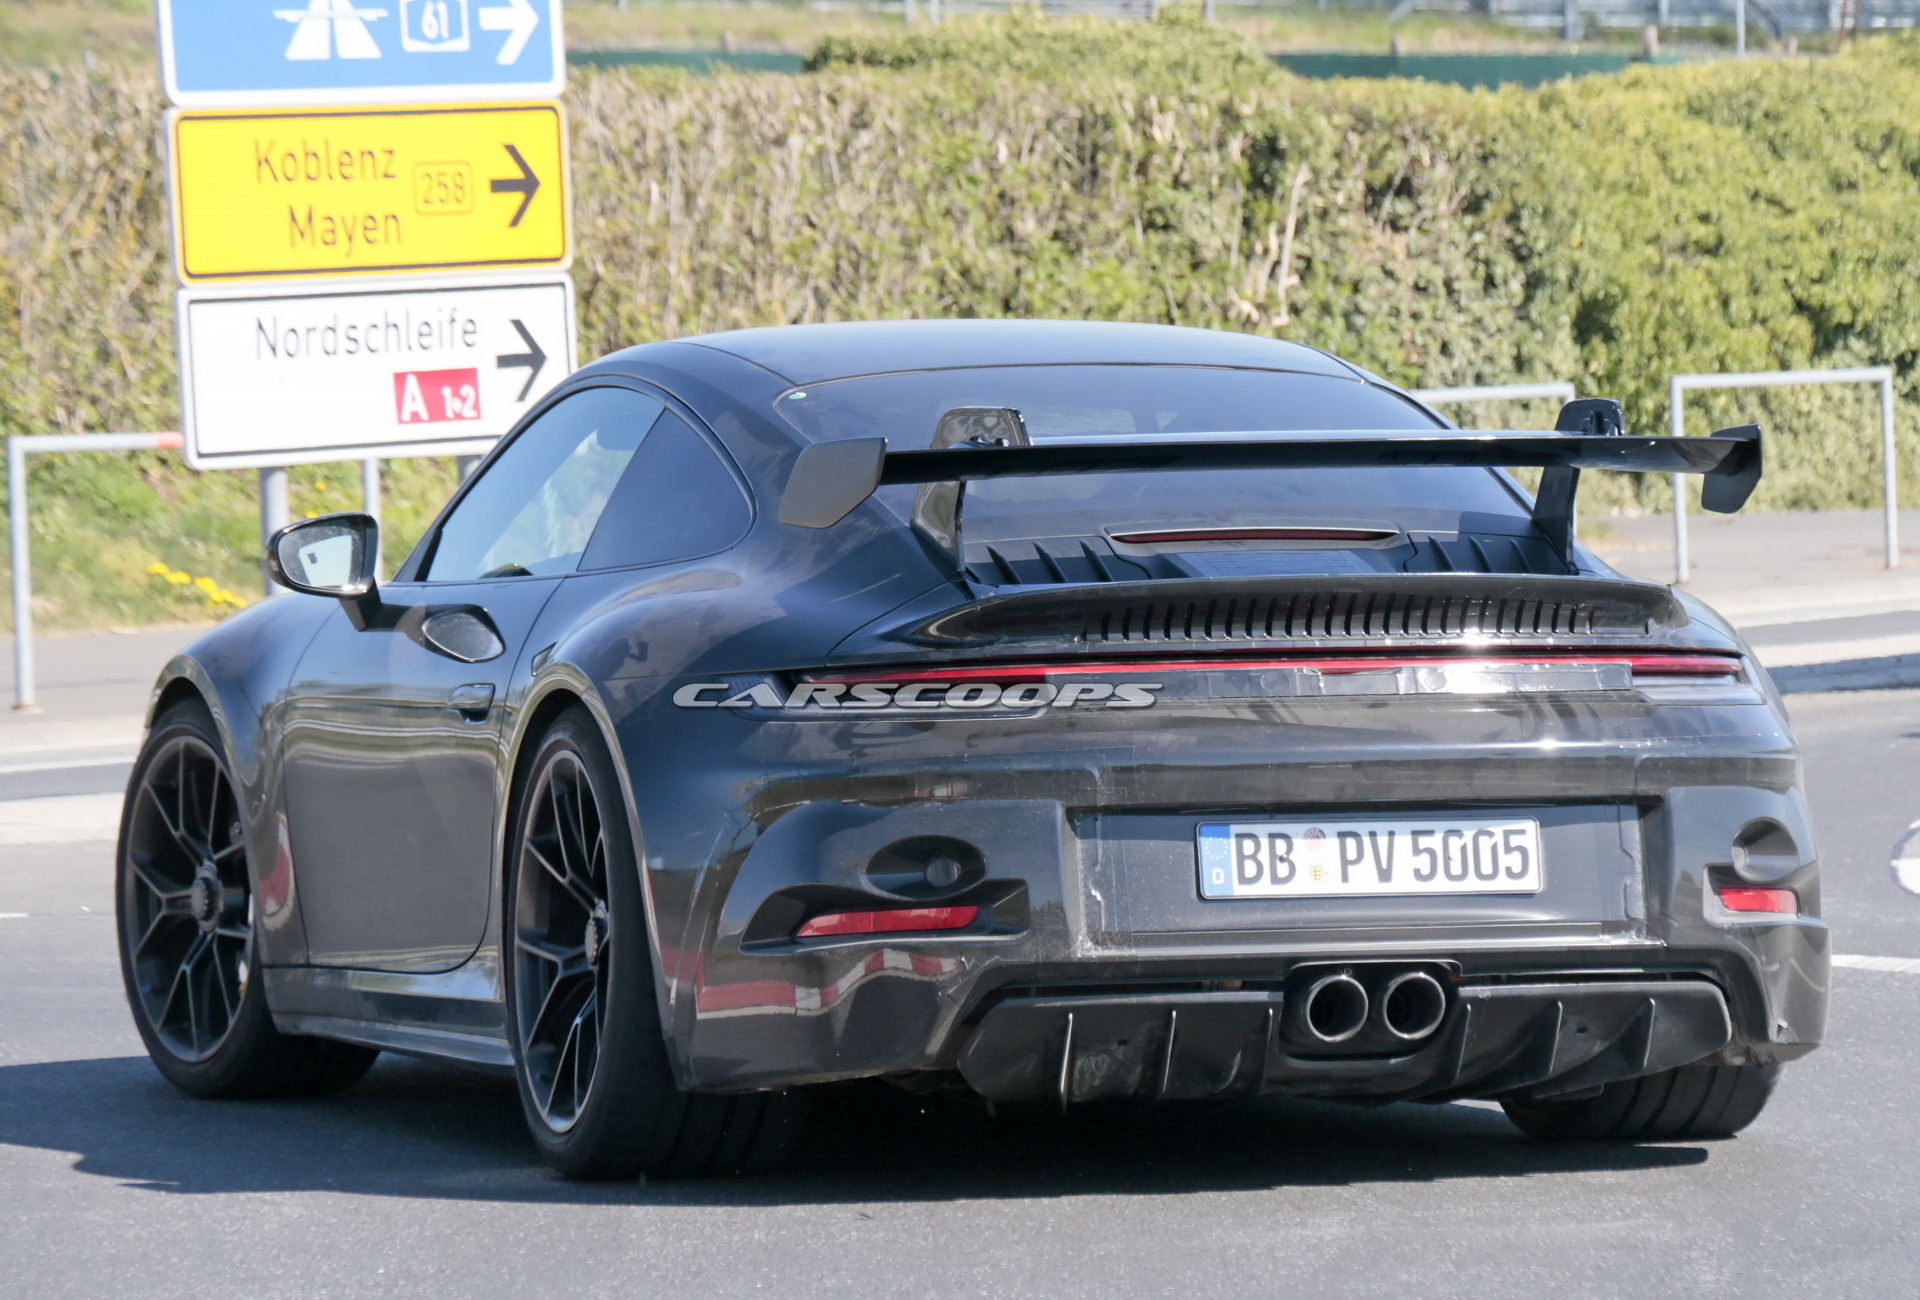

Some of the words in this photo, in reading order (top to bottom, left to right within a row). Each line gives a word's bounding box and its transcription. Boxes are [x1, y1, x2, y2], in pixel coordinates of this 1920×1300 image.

[421, 0, 449, 40] 61
[254, 137, 398, 184] Koblenz
[421, 170, 467, 205] 258
[287, 203, 403, 259] Mayen
[256, 306, 479, 360] Nordschleife
[401, 373, 430, 422] A
[1211, 867, 1225, 885] D
[1234, 831, 1297, 886] BB
[1336, 830, 1396, 884] PV
[1410, 828, 1530, 883] 5005
